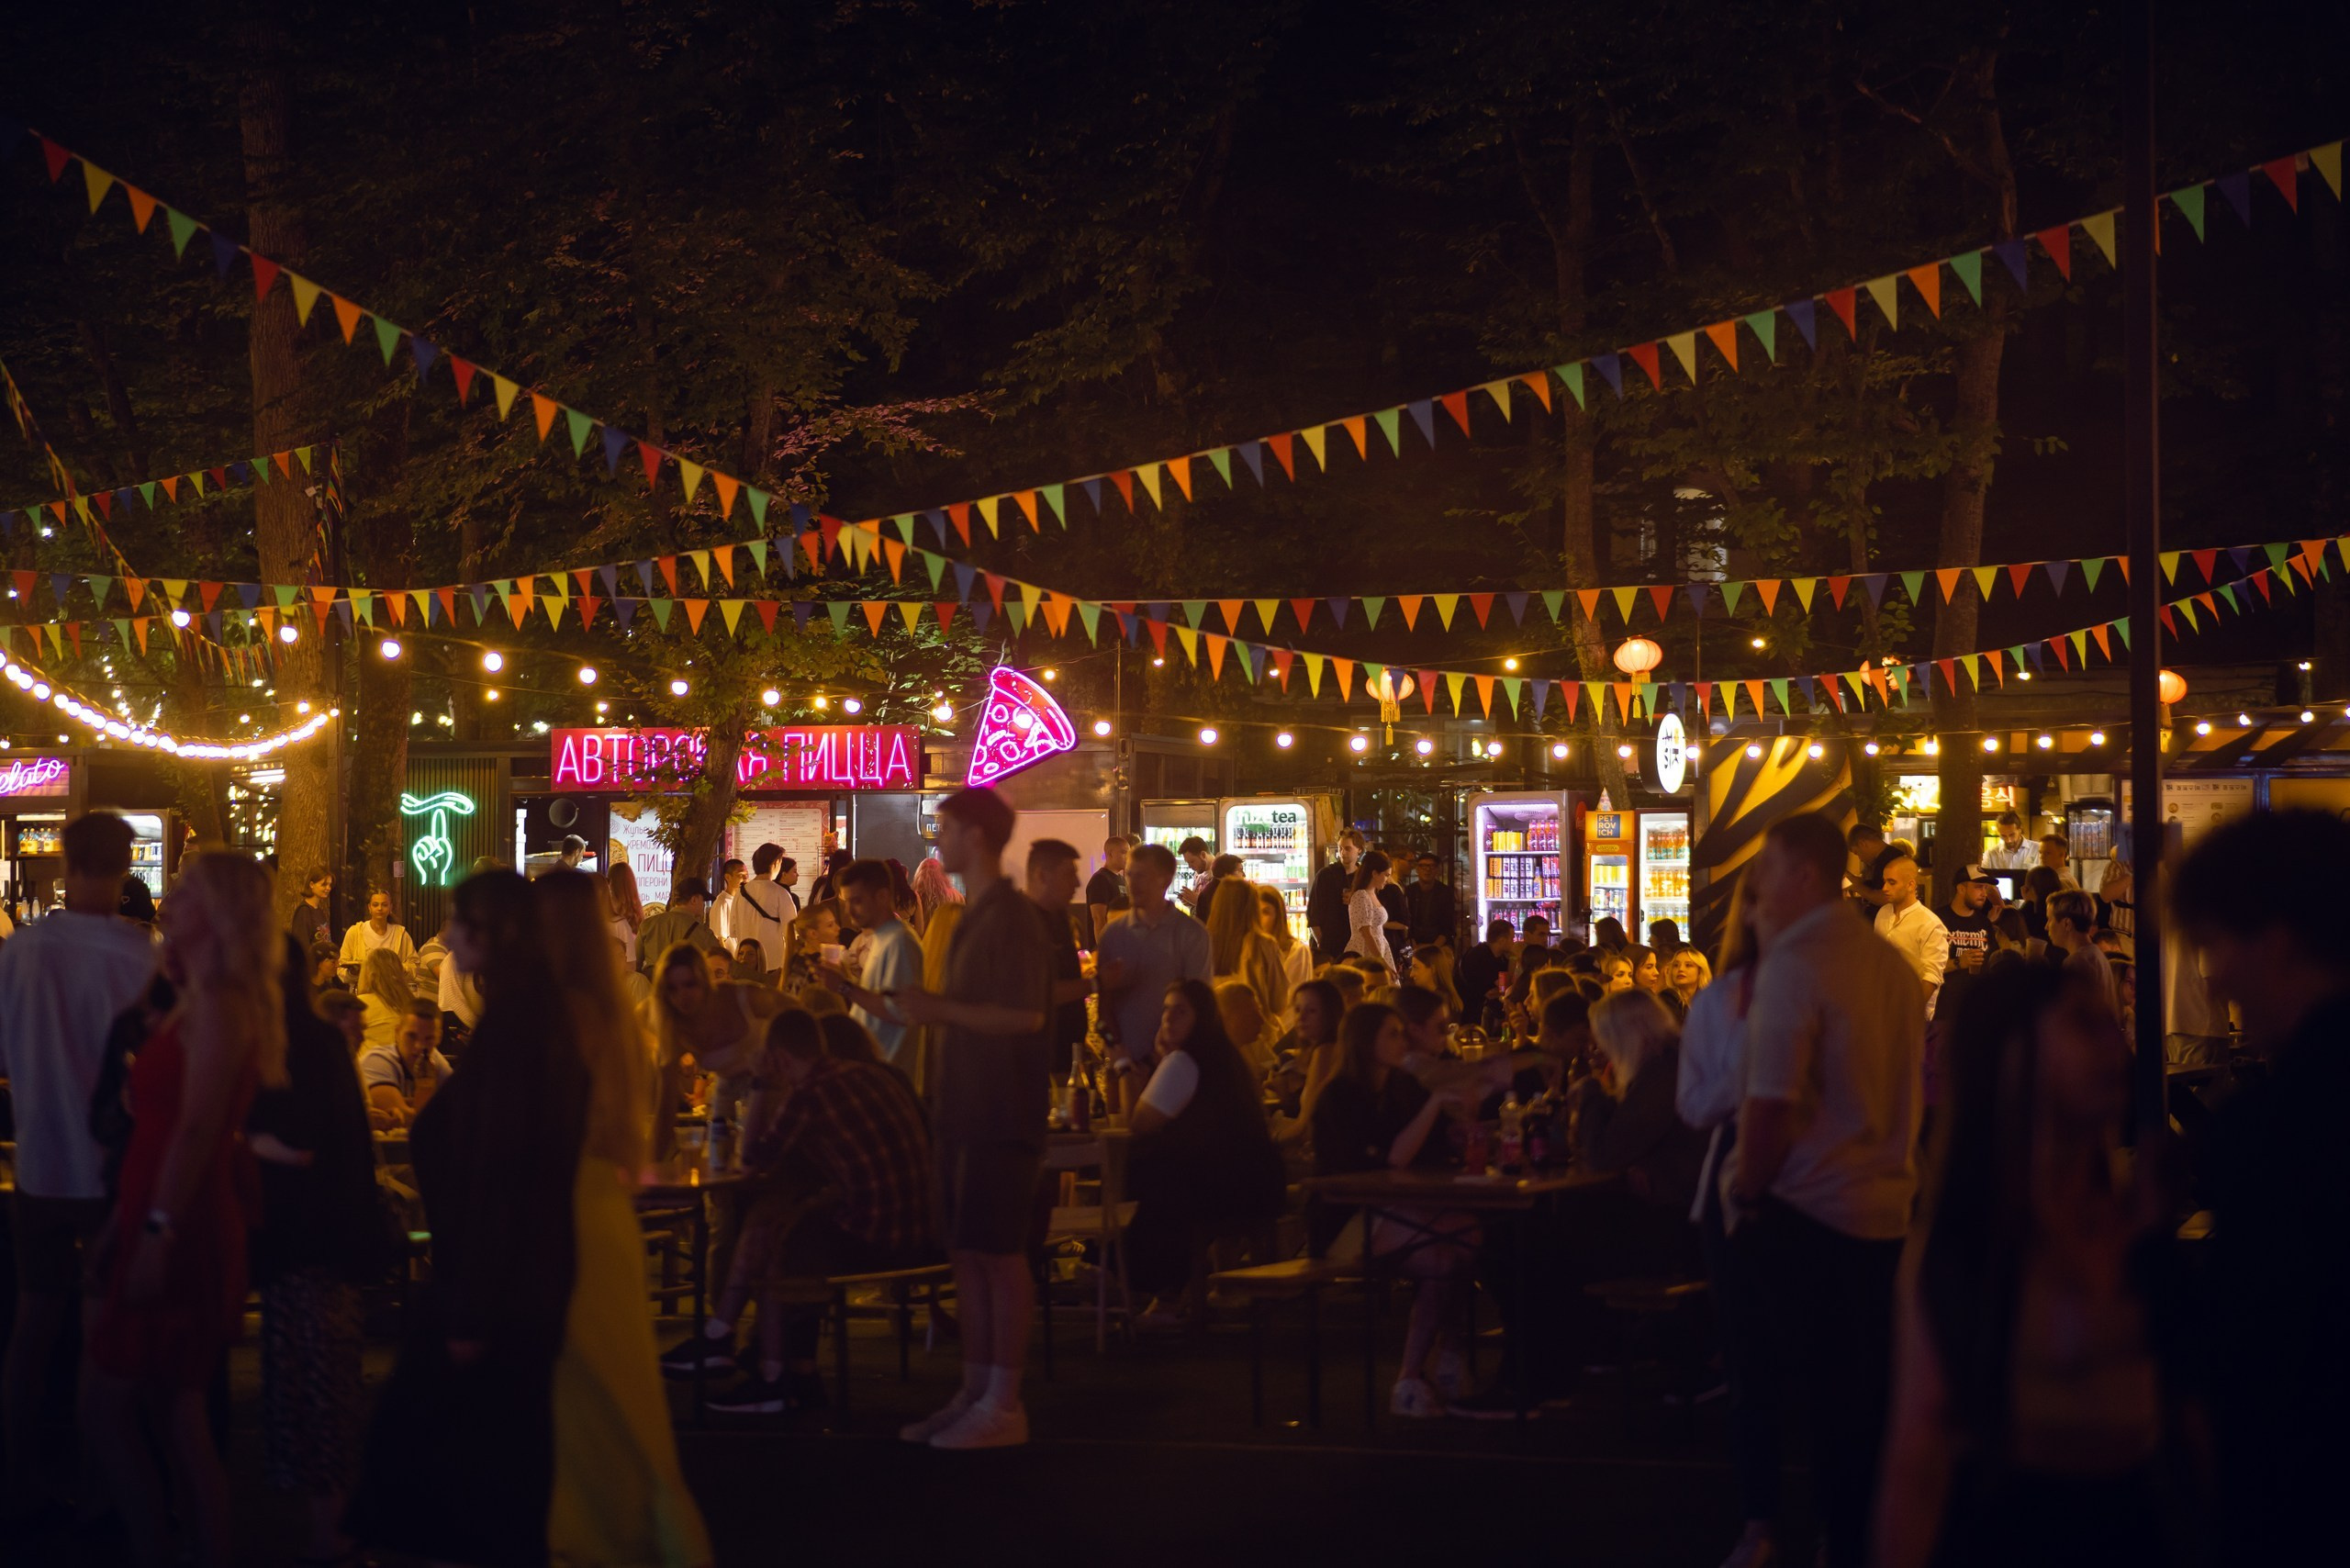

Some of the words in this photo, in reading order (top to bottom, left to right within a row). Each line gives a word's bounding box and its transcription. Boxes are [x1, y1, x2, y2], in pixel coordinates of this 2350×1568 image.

[0, 758, 65, 794] elato
[555, 733, 768, 783] АВТОРСЯ
[784, 732, 912, 787] ПИЦЦА
[1271, 811, 1296, 823] tea
